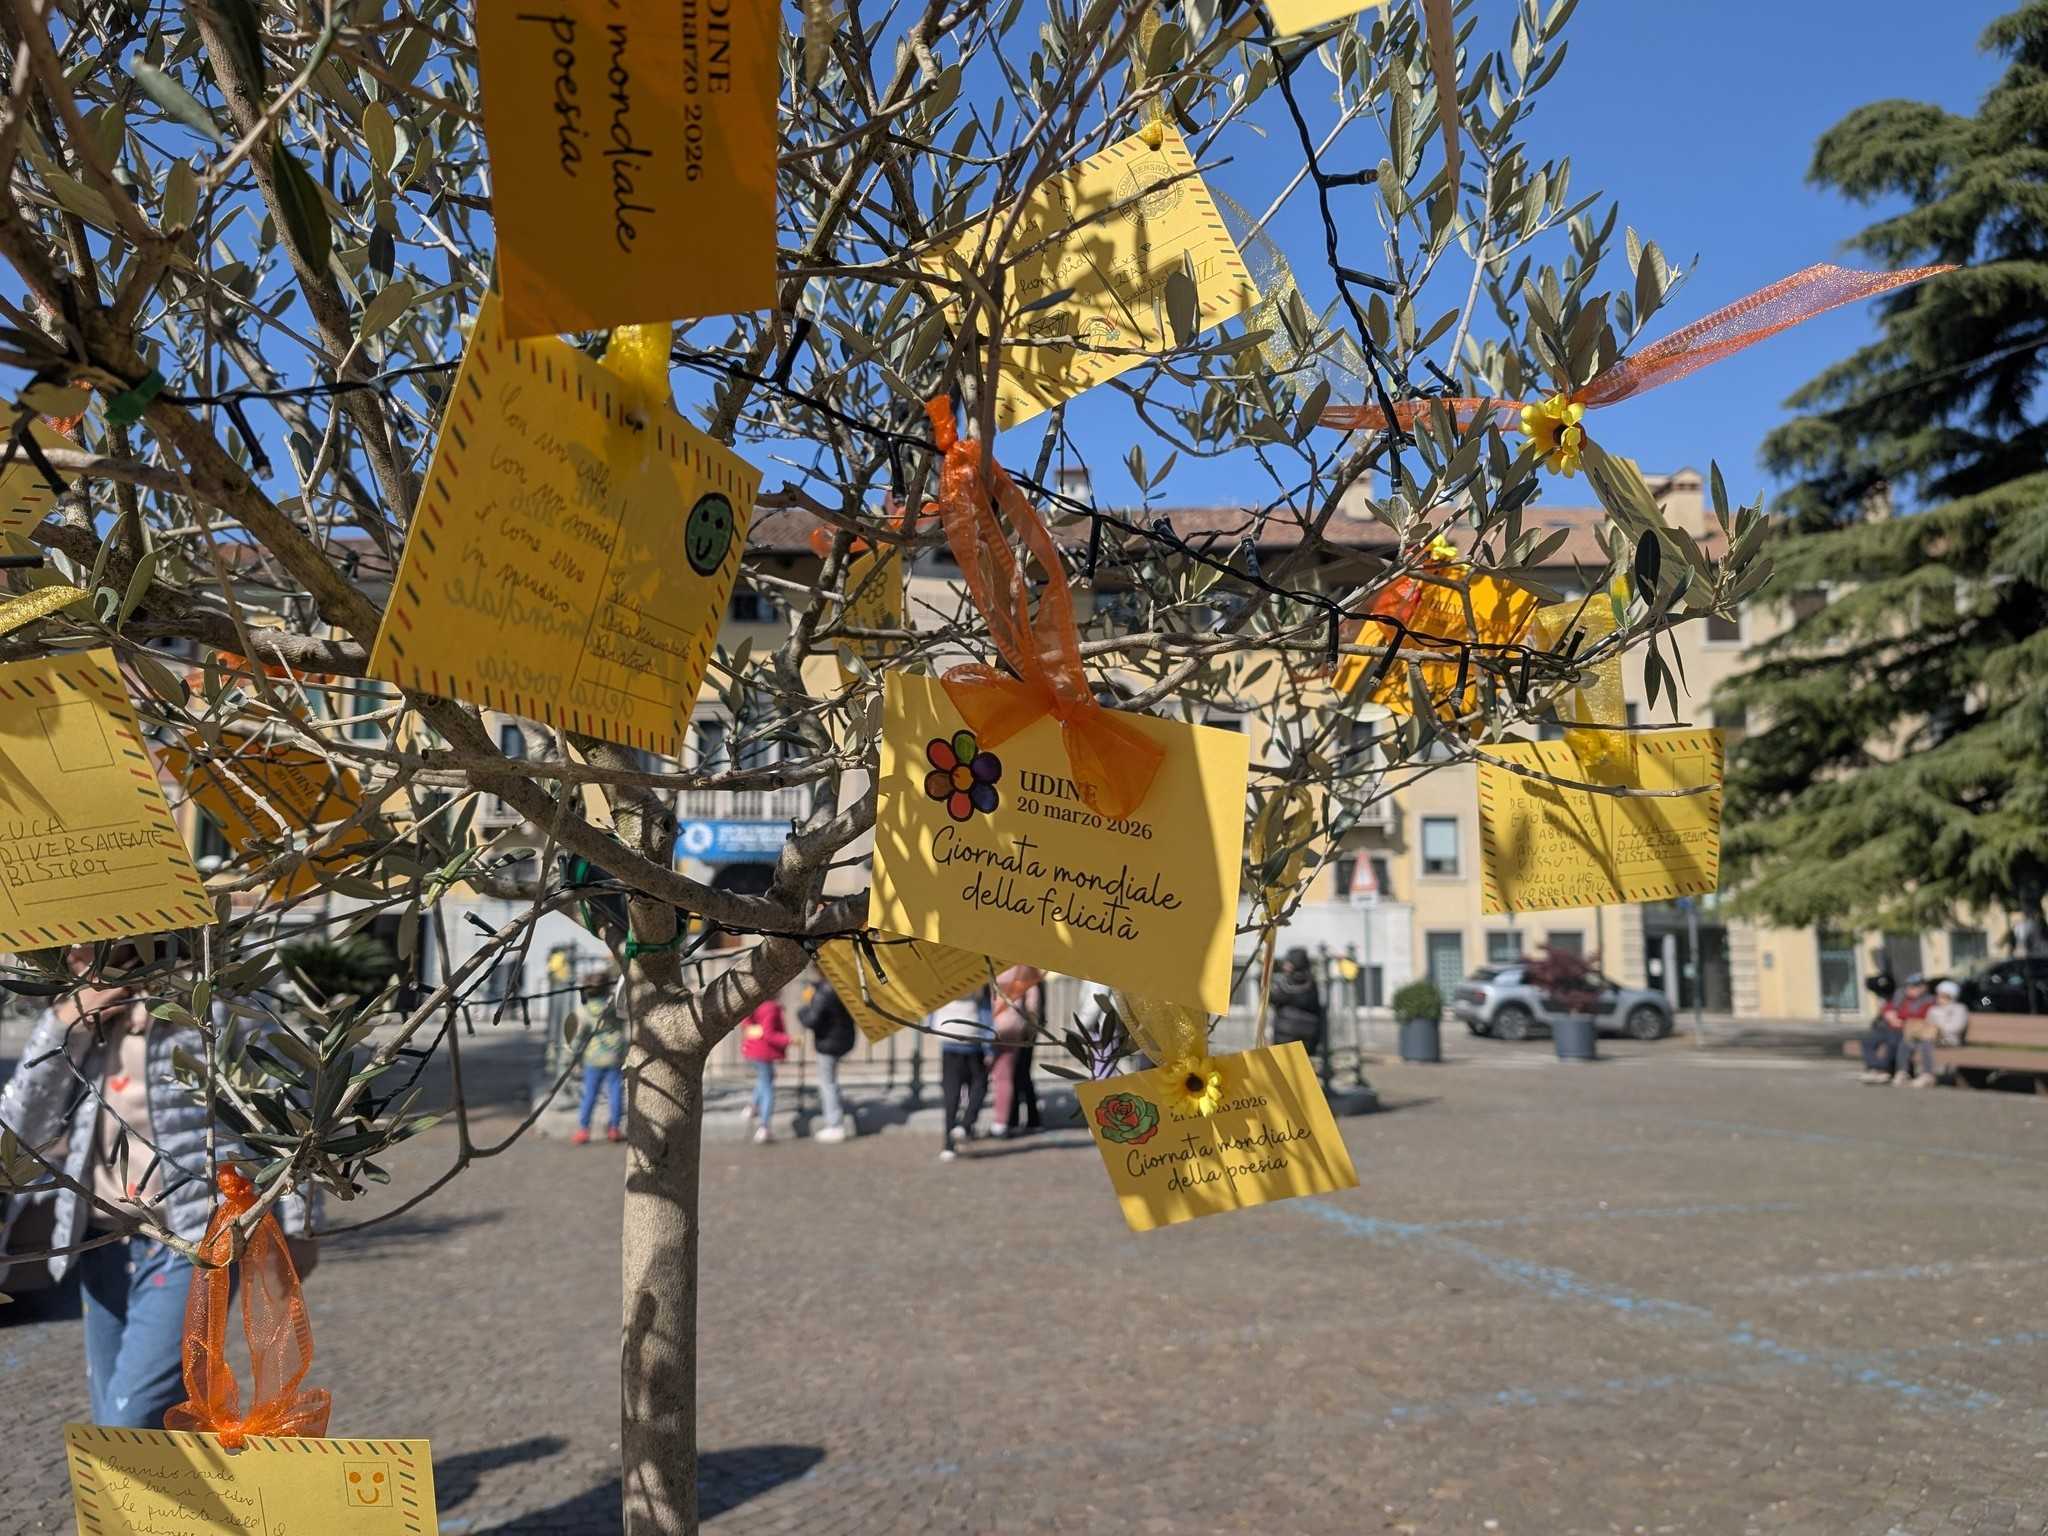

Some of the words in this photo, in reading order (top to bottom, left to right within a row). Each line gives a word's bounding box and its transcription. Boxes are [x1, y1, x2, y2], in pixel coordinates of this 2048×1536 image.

[706, 0, 731, 94] DINE
[516, 12, 589, 178] poesia
[603, 23, 655, 254] mondiale
[683, 104, 703, 181] 2026
[1020, 769, 1098, 802] UDINE
[1017, 796, 1039, 814] 20
[1044, 804, 1102, 829] marzo
[1107, 815, 1152, 840] 2026
[6, 859, 111, 887] BISTROT
[932, 825, 1047, 878] Giornata
[1053, 864, 1183, 910] mondiale
[962, 871, 1035, 915] della
[1037, 887, 1140, 941] felicità
[1232, 1095, 1268, 1112] 2026
[1127, 1132, 1213, 1177] Giornata
[1217, 1119, 1311, 1153] mondiale
[1168, 1162, 1223, 1193] della
[1225, 1155, 1288, 1193] poesia
